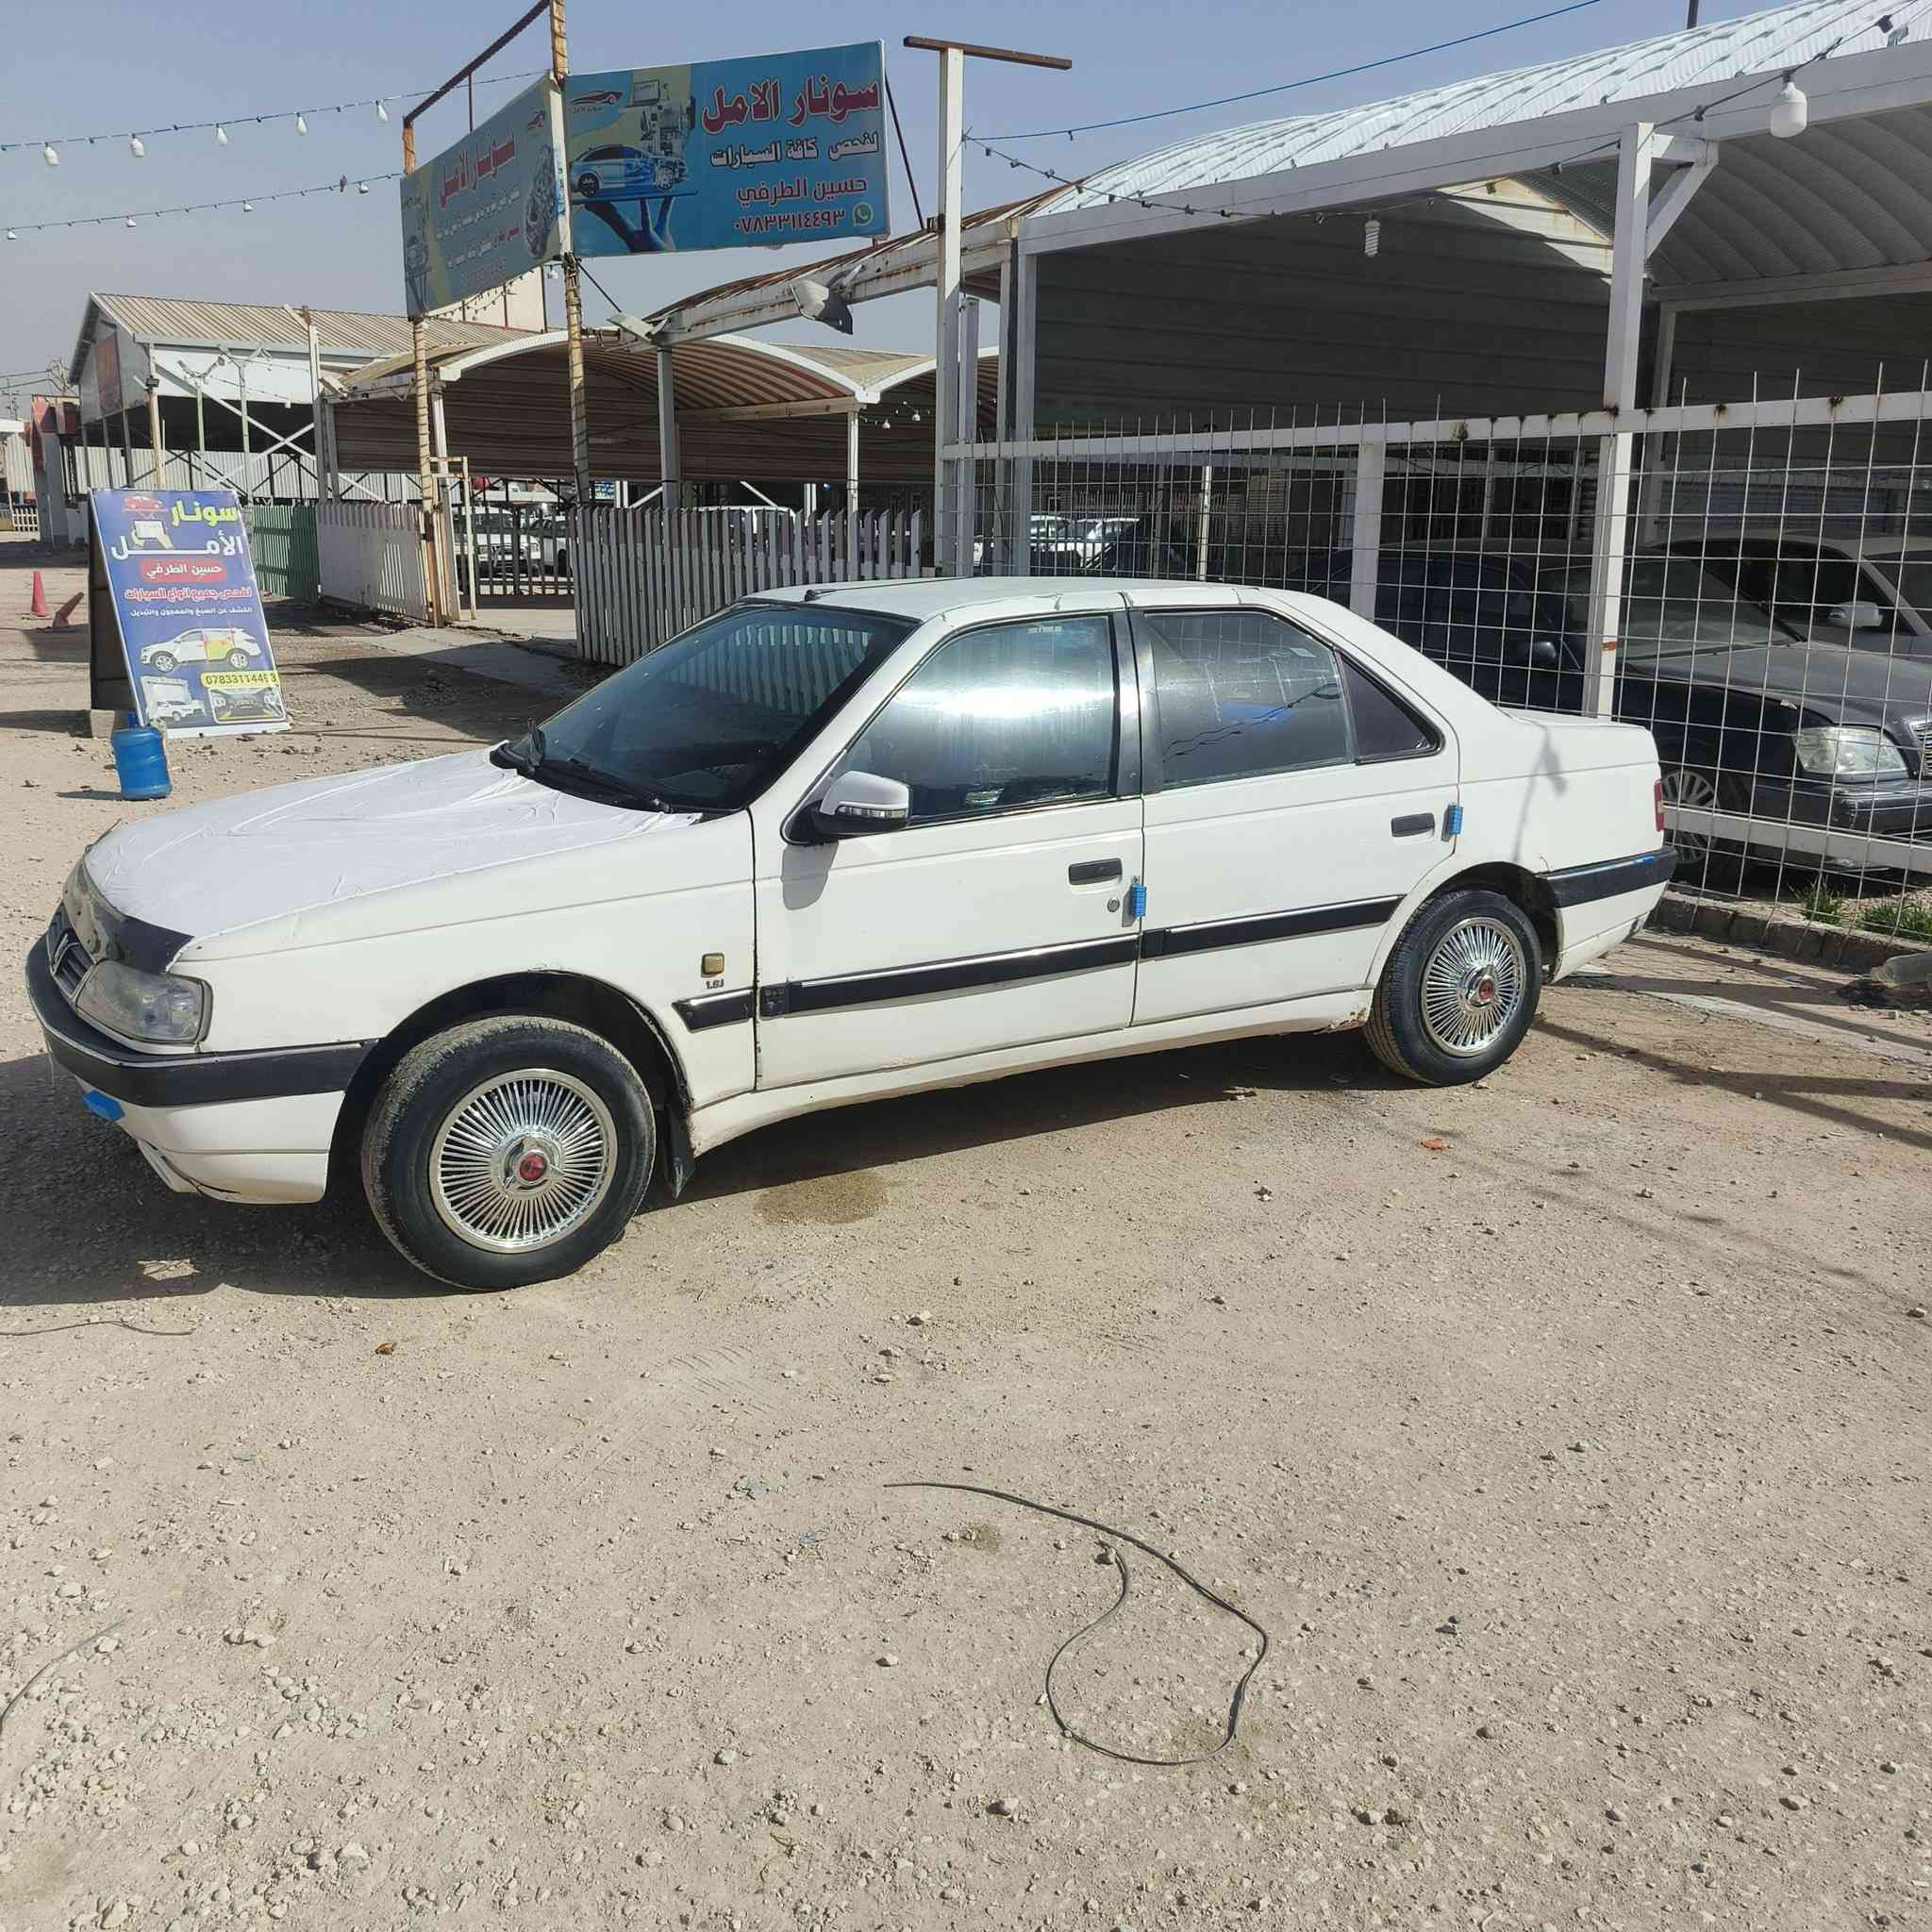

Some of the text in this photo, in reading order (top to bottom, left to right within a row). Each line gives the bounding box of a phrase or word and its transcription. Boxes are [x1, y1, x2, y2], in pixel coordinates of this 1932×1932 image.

[701, 73, 881, 134] سونار الامل
[708, 130, 880, 171] لفحص كافة السيارات
[736, 176, 868, 208] حسين الطرفي
[169, 499, 239, 527] سونار
[145, 563, 223, 580] حسين الطرفي
[124, 586, 168, 603] السيارات
[191, 587, 219, 603] جميع
[220, 586, 252, 601] لفحص
